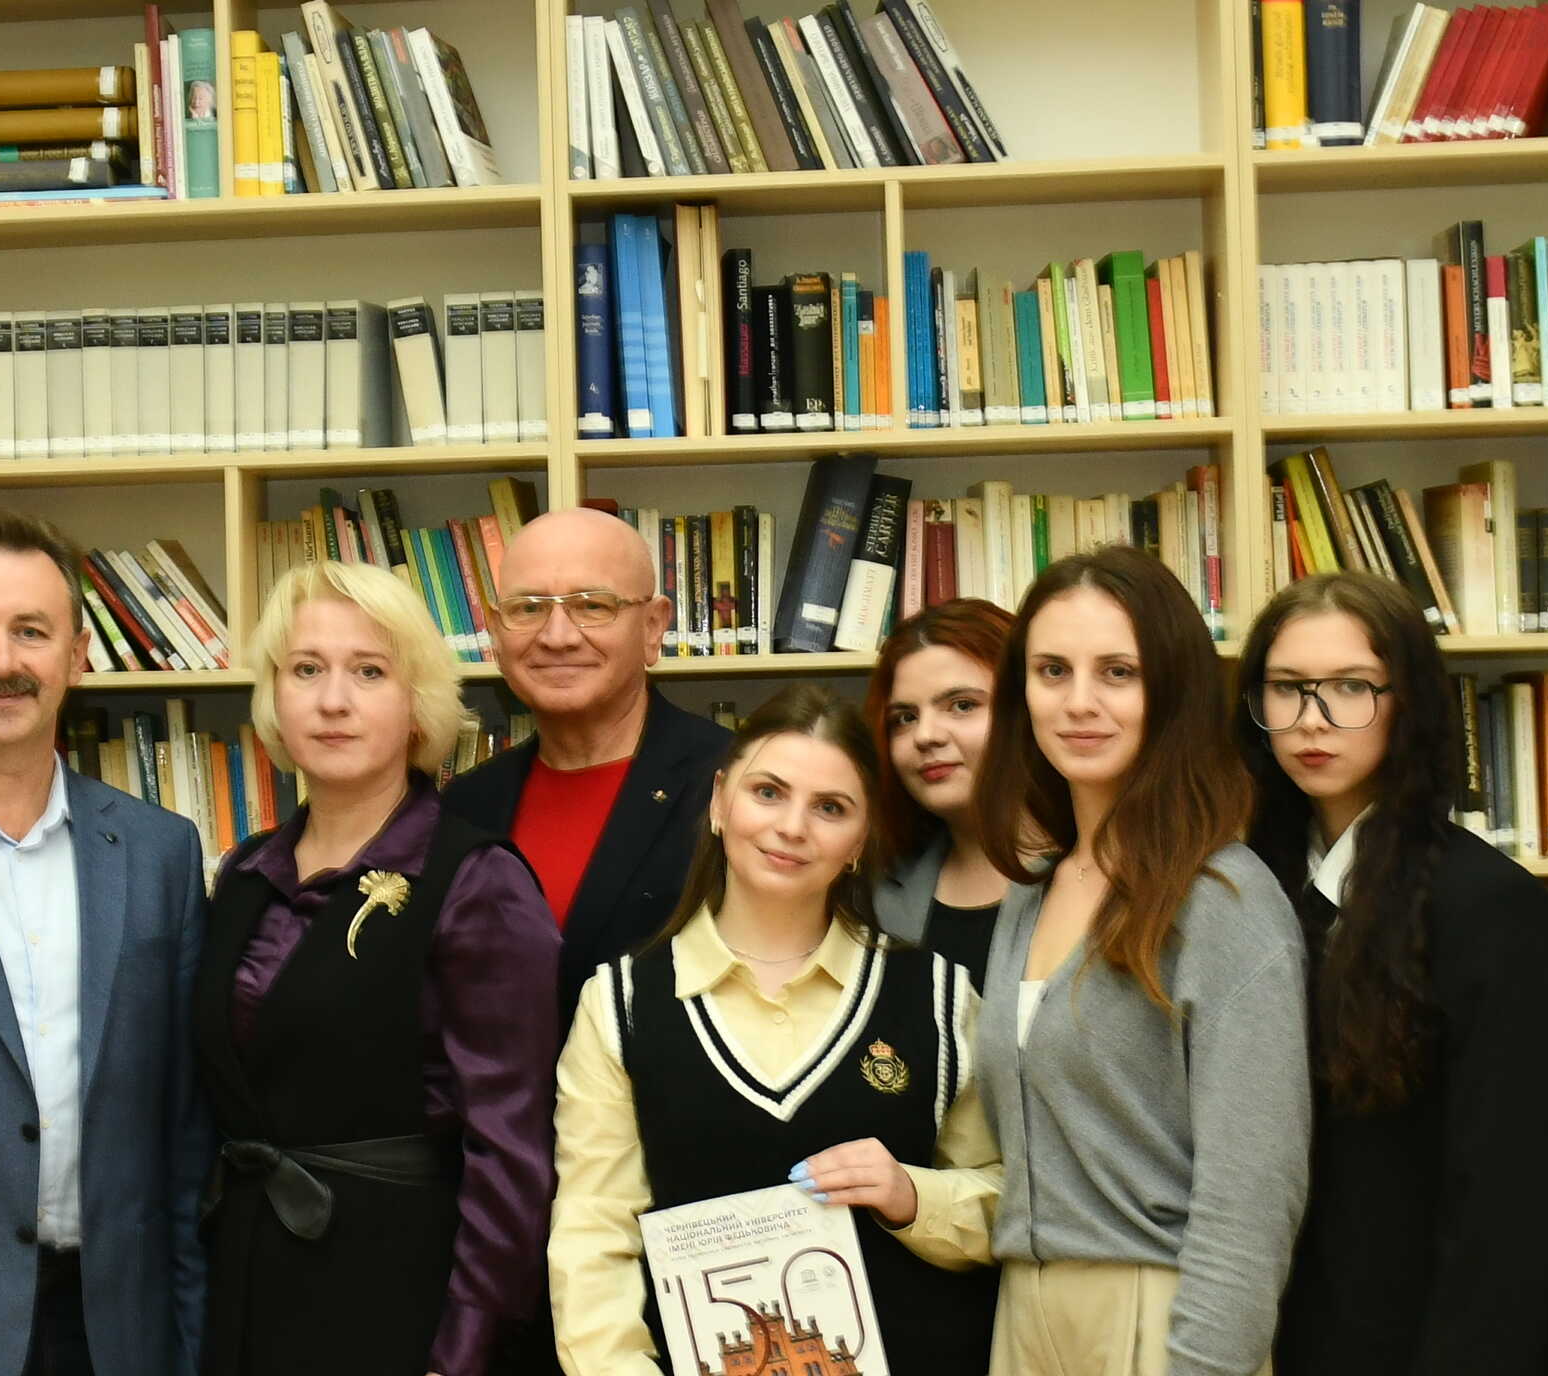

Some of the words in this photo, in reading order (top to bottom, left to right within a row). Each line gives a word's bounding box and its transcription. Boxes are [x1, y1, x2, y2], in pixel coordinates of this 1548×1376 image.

[736, 259, 748, 311] Santiago
[875, 493, 901, 558] CARTER
[663, 1212, 737, 1234] ЧЕРНІВЕЦЬКИЙ
[665, 1220, 744, 1244] НАЦІОНАЛЬНИЙ
[745, 1207, 809, 1227] УНІВЕРСИТЕТ
